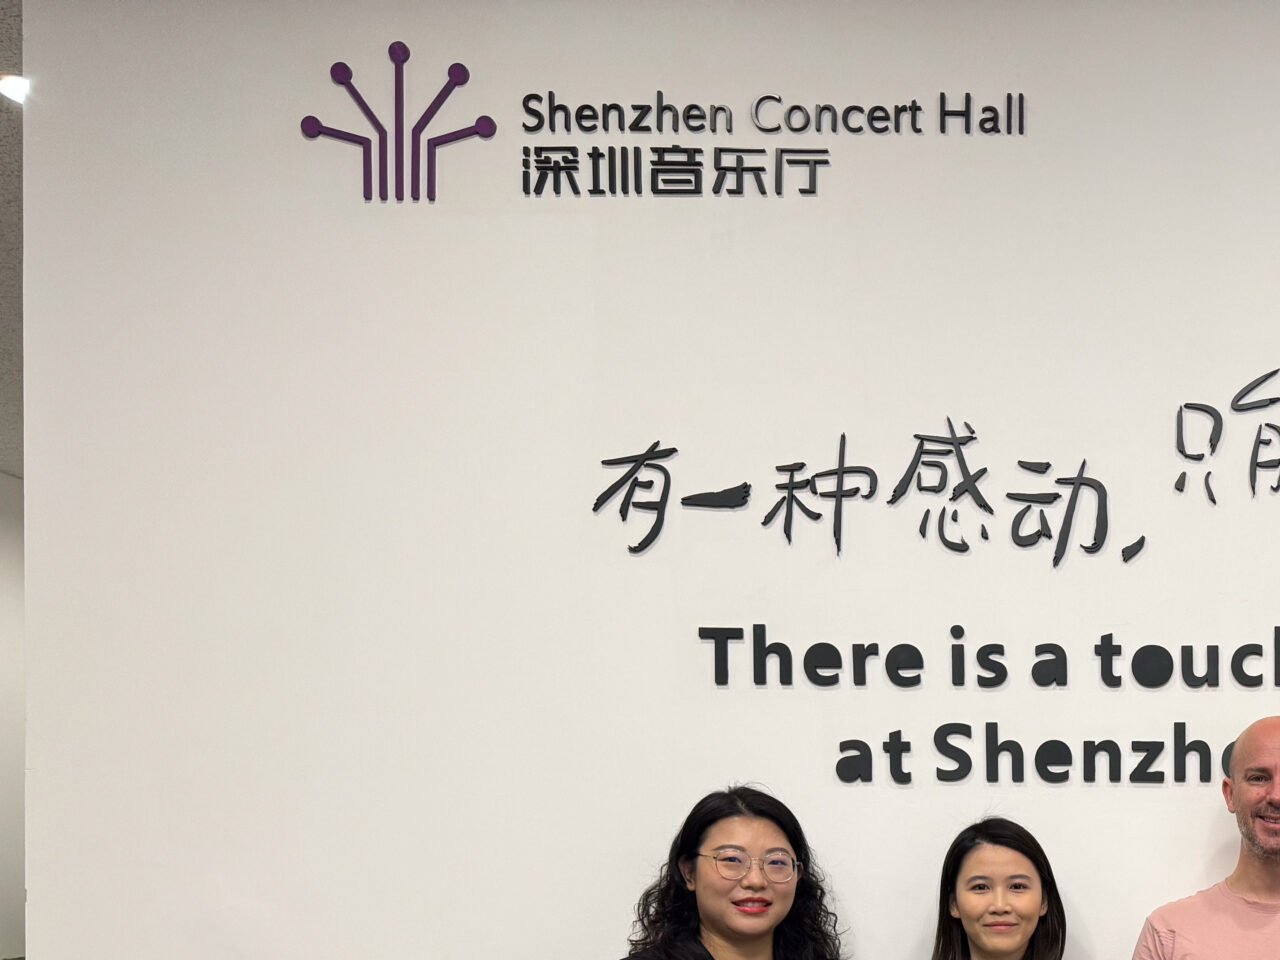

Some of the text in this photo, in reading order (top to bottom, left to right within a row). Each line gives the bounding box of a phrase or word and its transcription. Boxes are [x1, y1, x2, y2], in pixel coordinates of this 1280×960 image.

[522, 91, 1025, 136] Shenzhen Concert Hall
[522, 145, 830, 197] 深圳音乐厅
[698, 623, 924, 688] There
[950, 624, 1008, 689] is
[1031, 643, 1068, 688] a
[835, 729, 912, 785] at
[933, 722, 1238, 785] Shenzh
